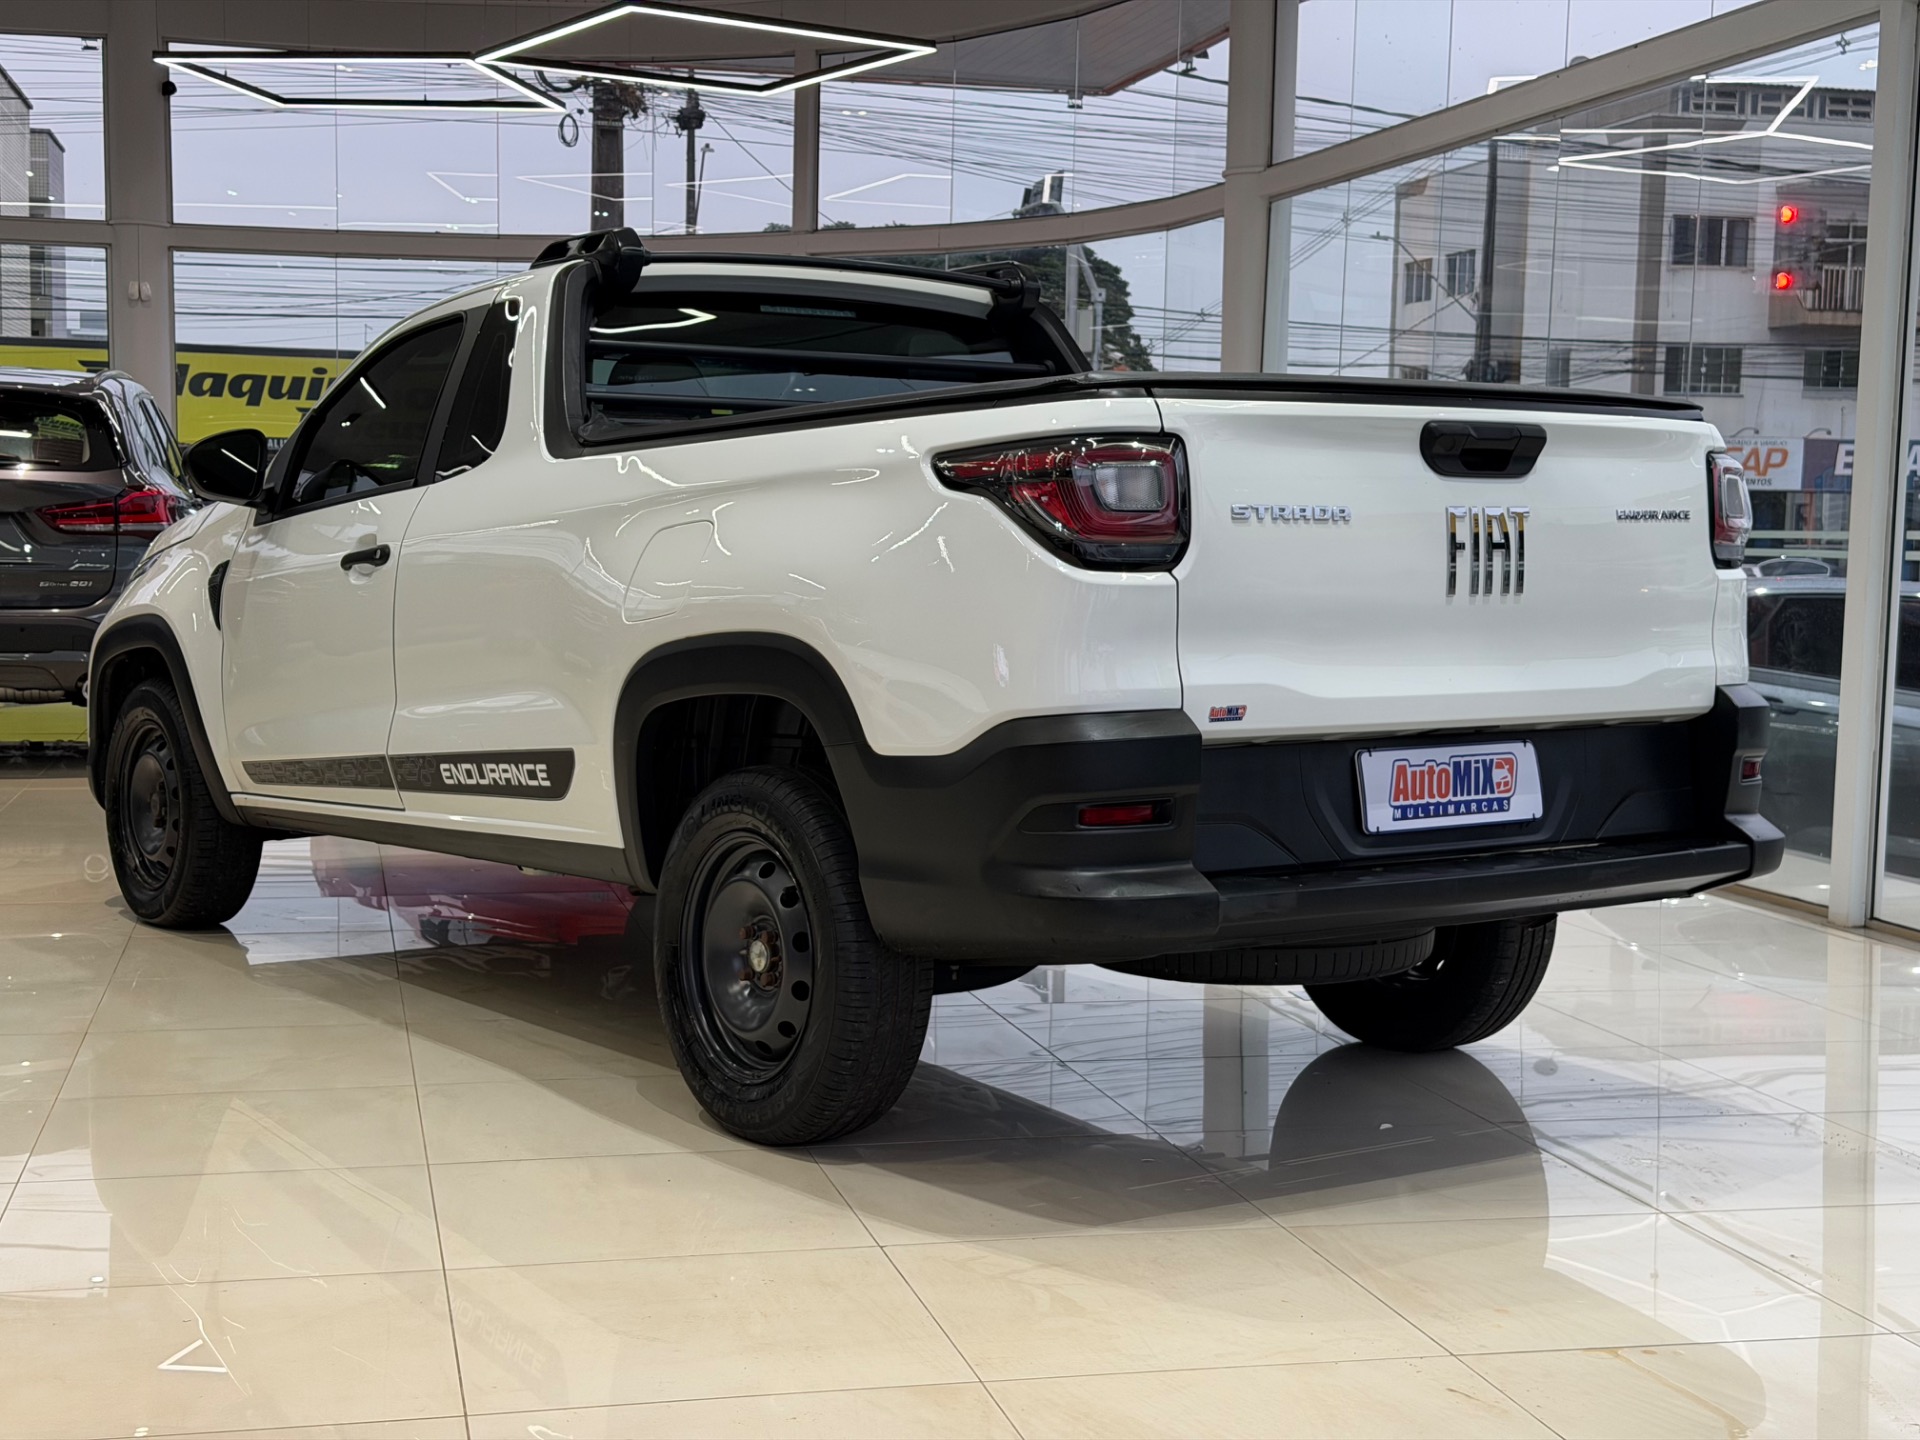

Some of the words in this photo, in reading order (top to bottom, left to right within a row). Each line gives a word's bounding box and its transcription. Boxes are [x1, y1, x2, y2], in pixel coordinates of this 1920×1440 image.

[1231, 503, 1352, 522] STRADA
[1615, 508, 1691, 521] ENDURANCE
[1445, 505, 1531, 598] FIAT
[439, 763, 552, 787] ENDURANCE
[1393, 799, 1510, 819] MULTIMARCAS
